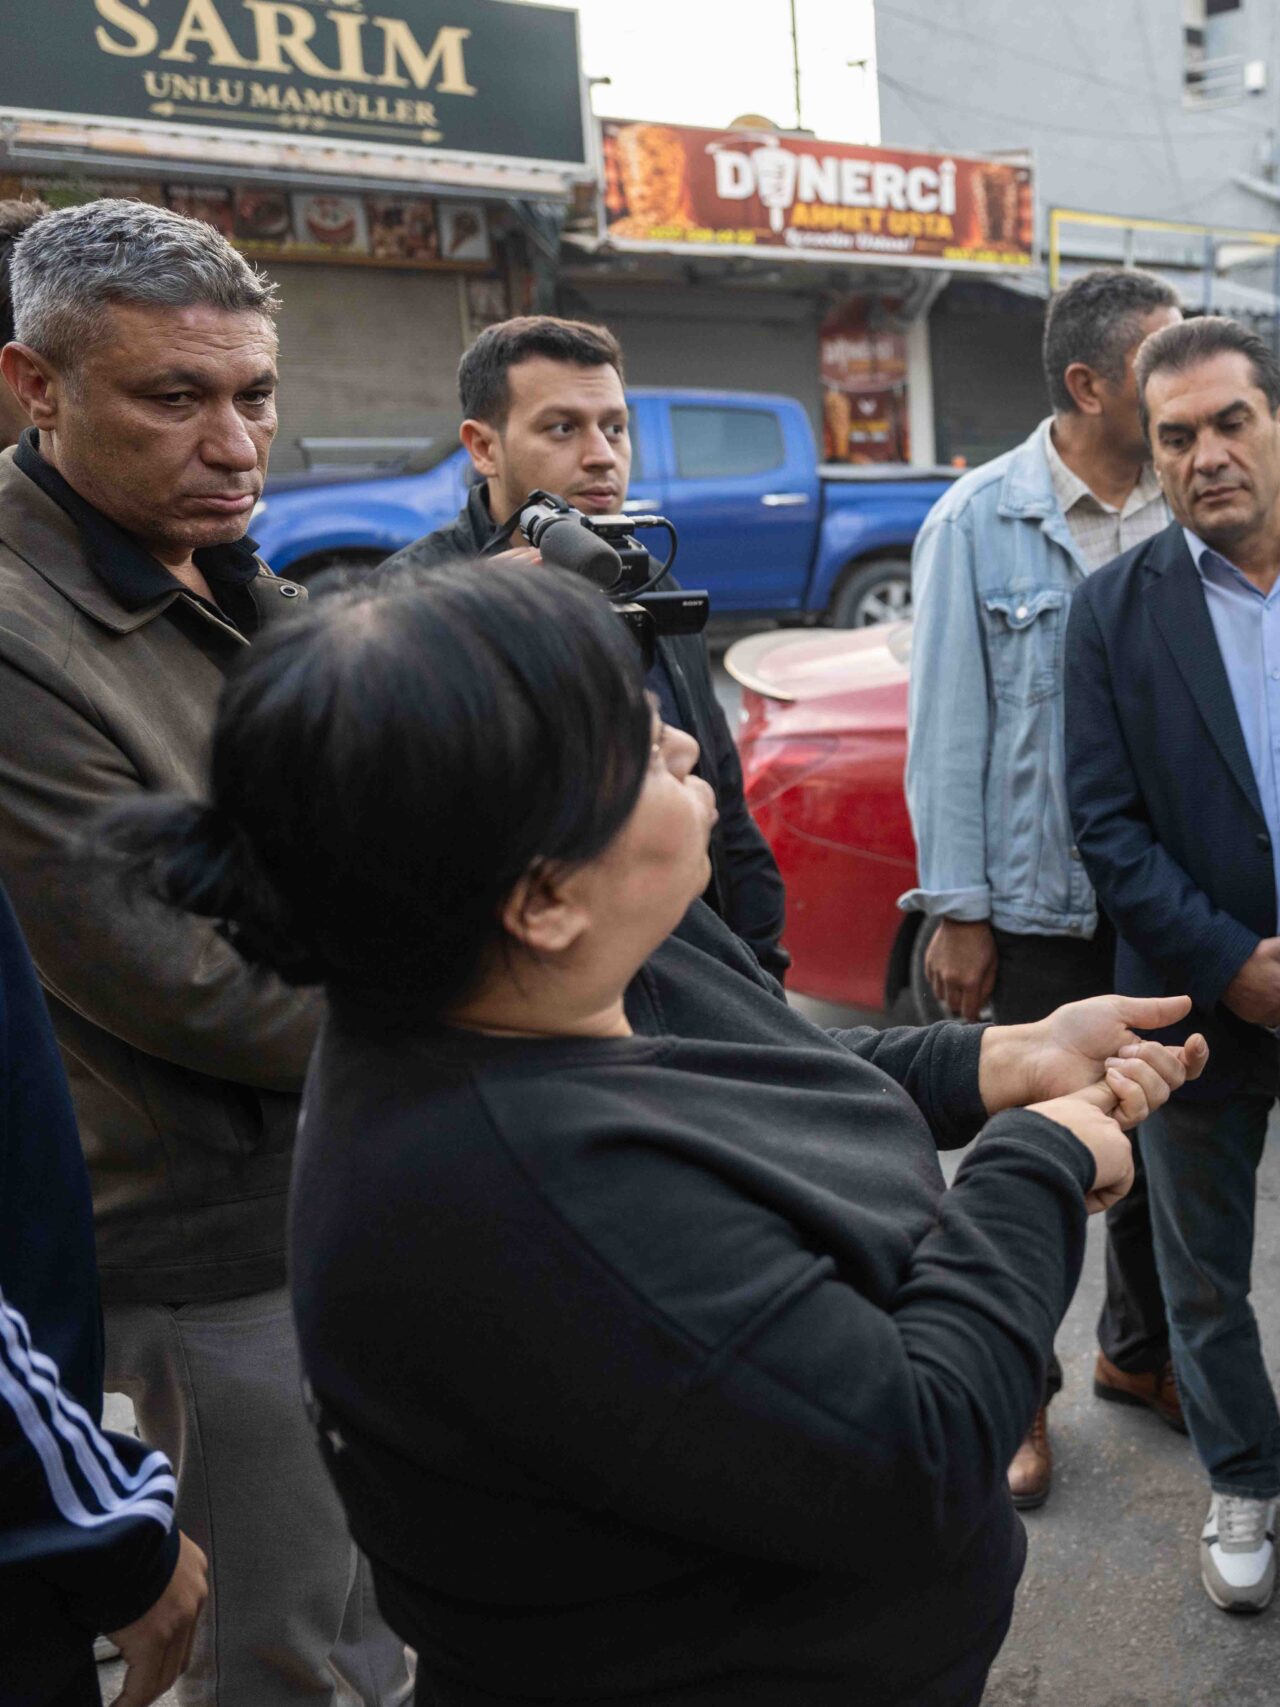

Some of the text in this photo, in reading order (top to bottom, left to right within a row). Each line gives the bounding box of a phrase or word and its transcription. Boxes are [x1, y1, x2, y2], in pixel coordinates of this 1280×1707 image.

[143, 70, 439, 126] UNLU MAMÜLLER
[790, 201, 955, 238] AHMET USTA
